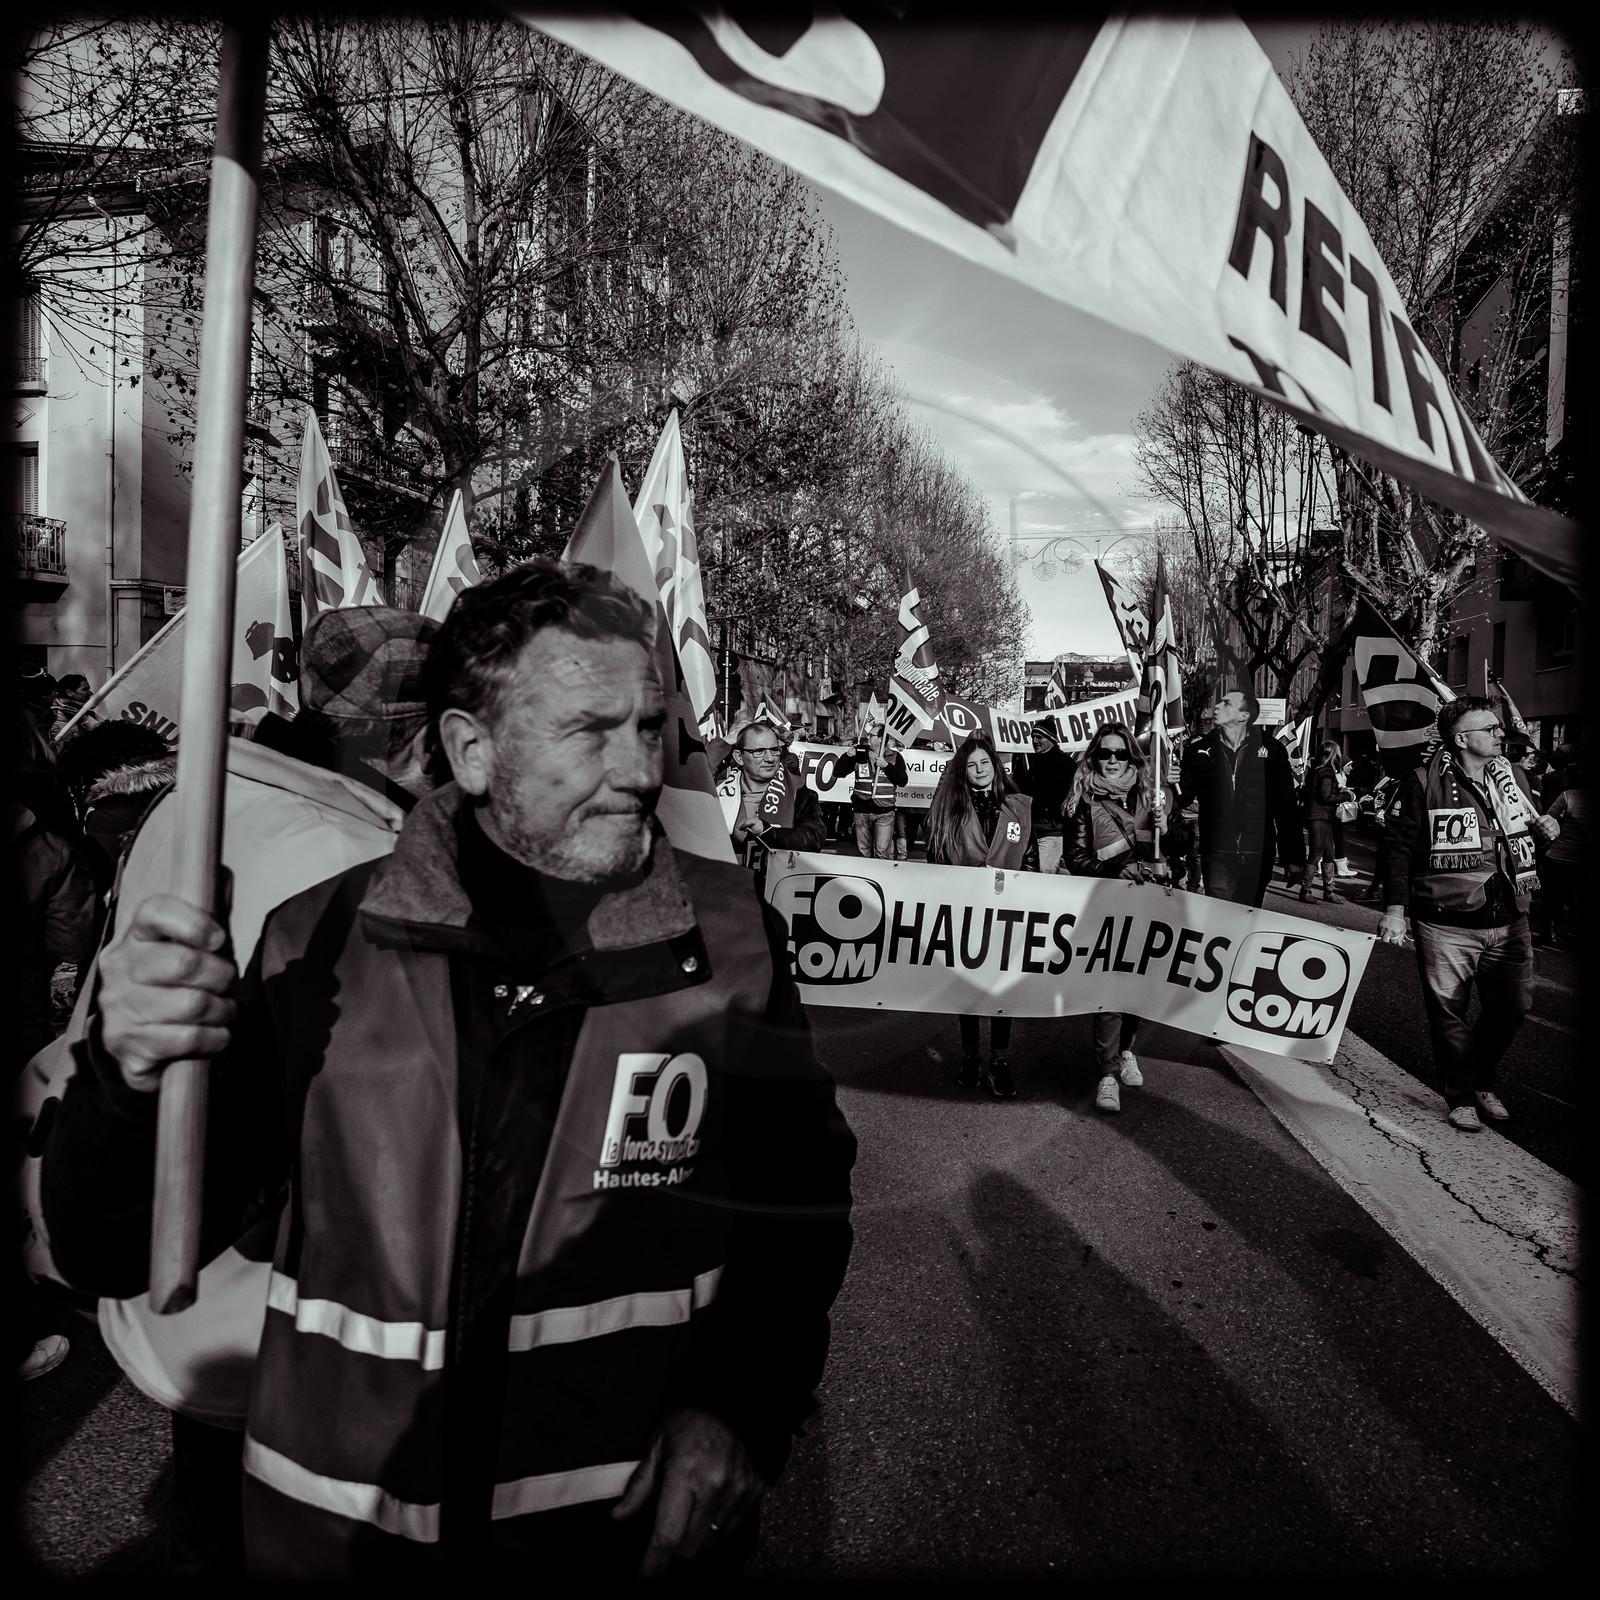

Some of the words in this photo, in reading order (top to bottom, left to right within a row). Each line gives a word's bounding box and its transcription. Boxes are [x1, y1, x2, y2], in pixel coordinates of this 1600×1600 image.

[893, 656, 941, 704] syndicale
[1068, 711, 1094, 742] DE
[1432, 814, 1466, 845] FO
[771, 876, 883, 940] FO
[887, 900, 1233, 993] HAUTES-ALPES
[1230, 934, 1347, 1000] FO
[1227, 988, 1334, 1036] COM
[600, 1051, 709, 1167] FO
